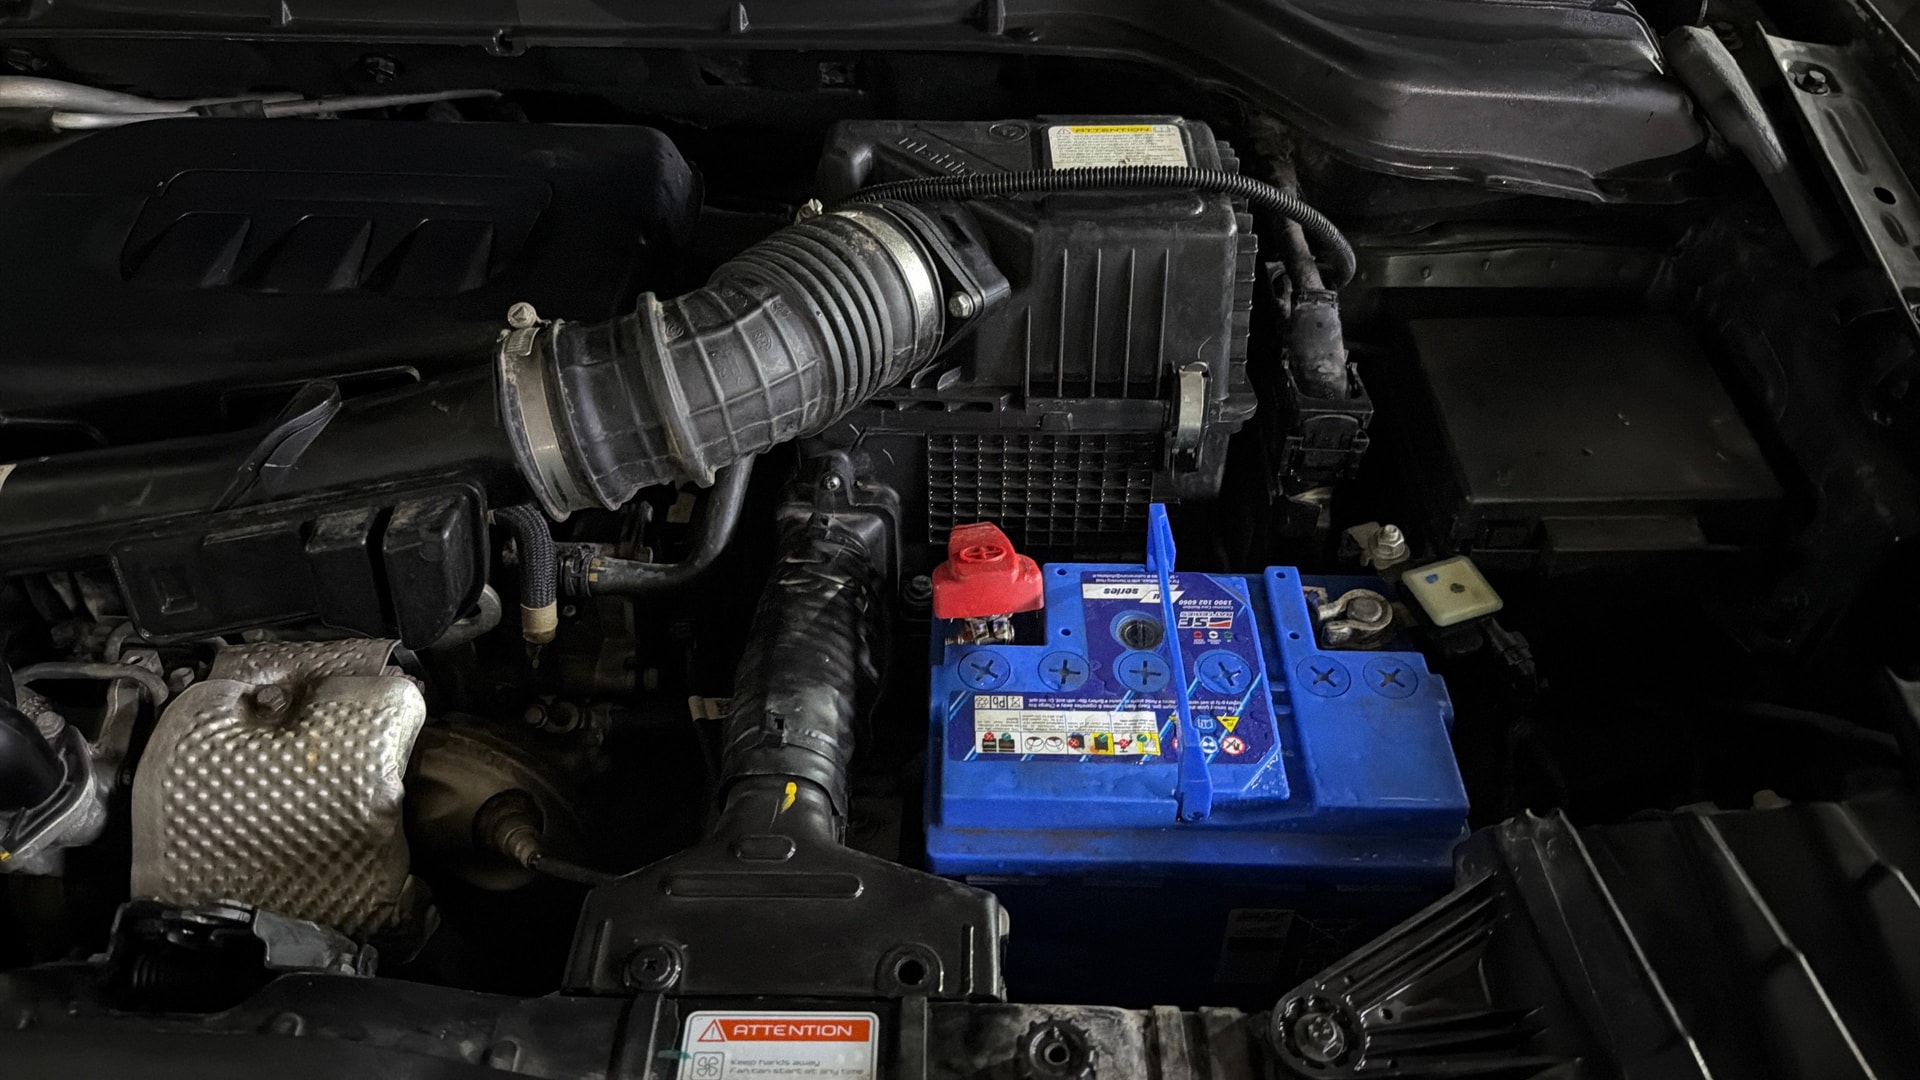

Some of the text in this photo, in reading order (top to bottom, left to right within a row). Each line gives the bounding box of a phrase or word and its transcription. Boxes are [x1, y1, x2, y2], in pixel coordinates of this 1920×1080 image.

[1178, 617, 1209, 628] SF
[992, 697, 1005, 707] Pb
[733, 1025, 852, 1036] ATTENTION
